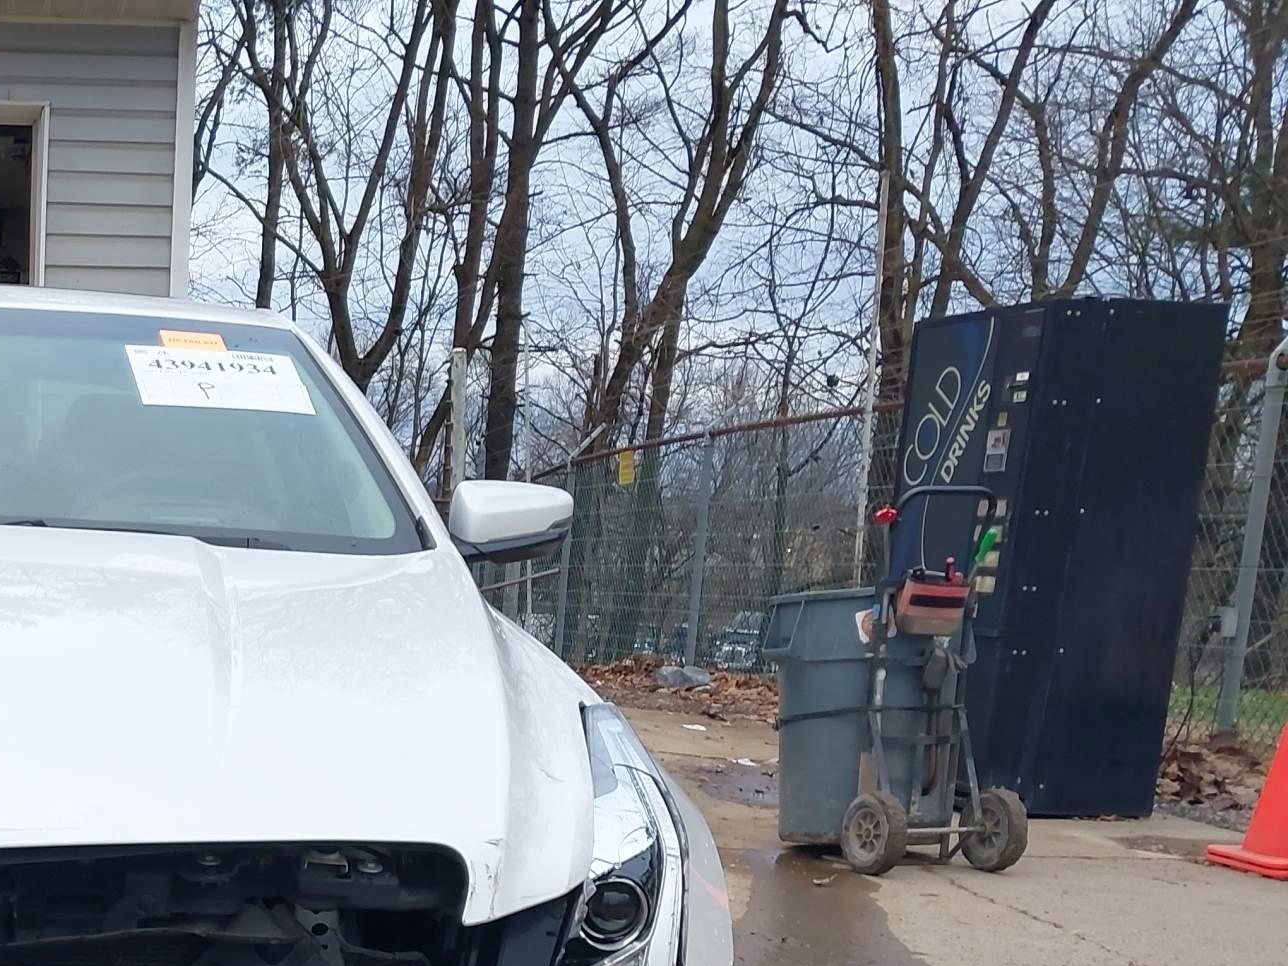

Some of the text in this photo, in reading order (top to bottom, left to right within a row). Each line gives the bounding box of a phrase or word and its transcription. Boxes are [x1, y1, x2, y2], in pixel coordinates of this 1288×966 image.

[148, 359, 277, 375] 43941934
[903, 366, 961, 486] COLD
[940, 379, 991, 484] DRINKS
